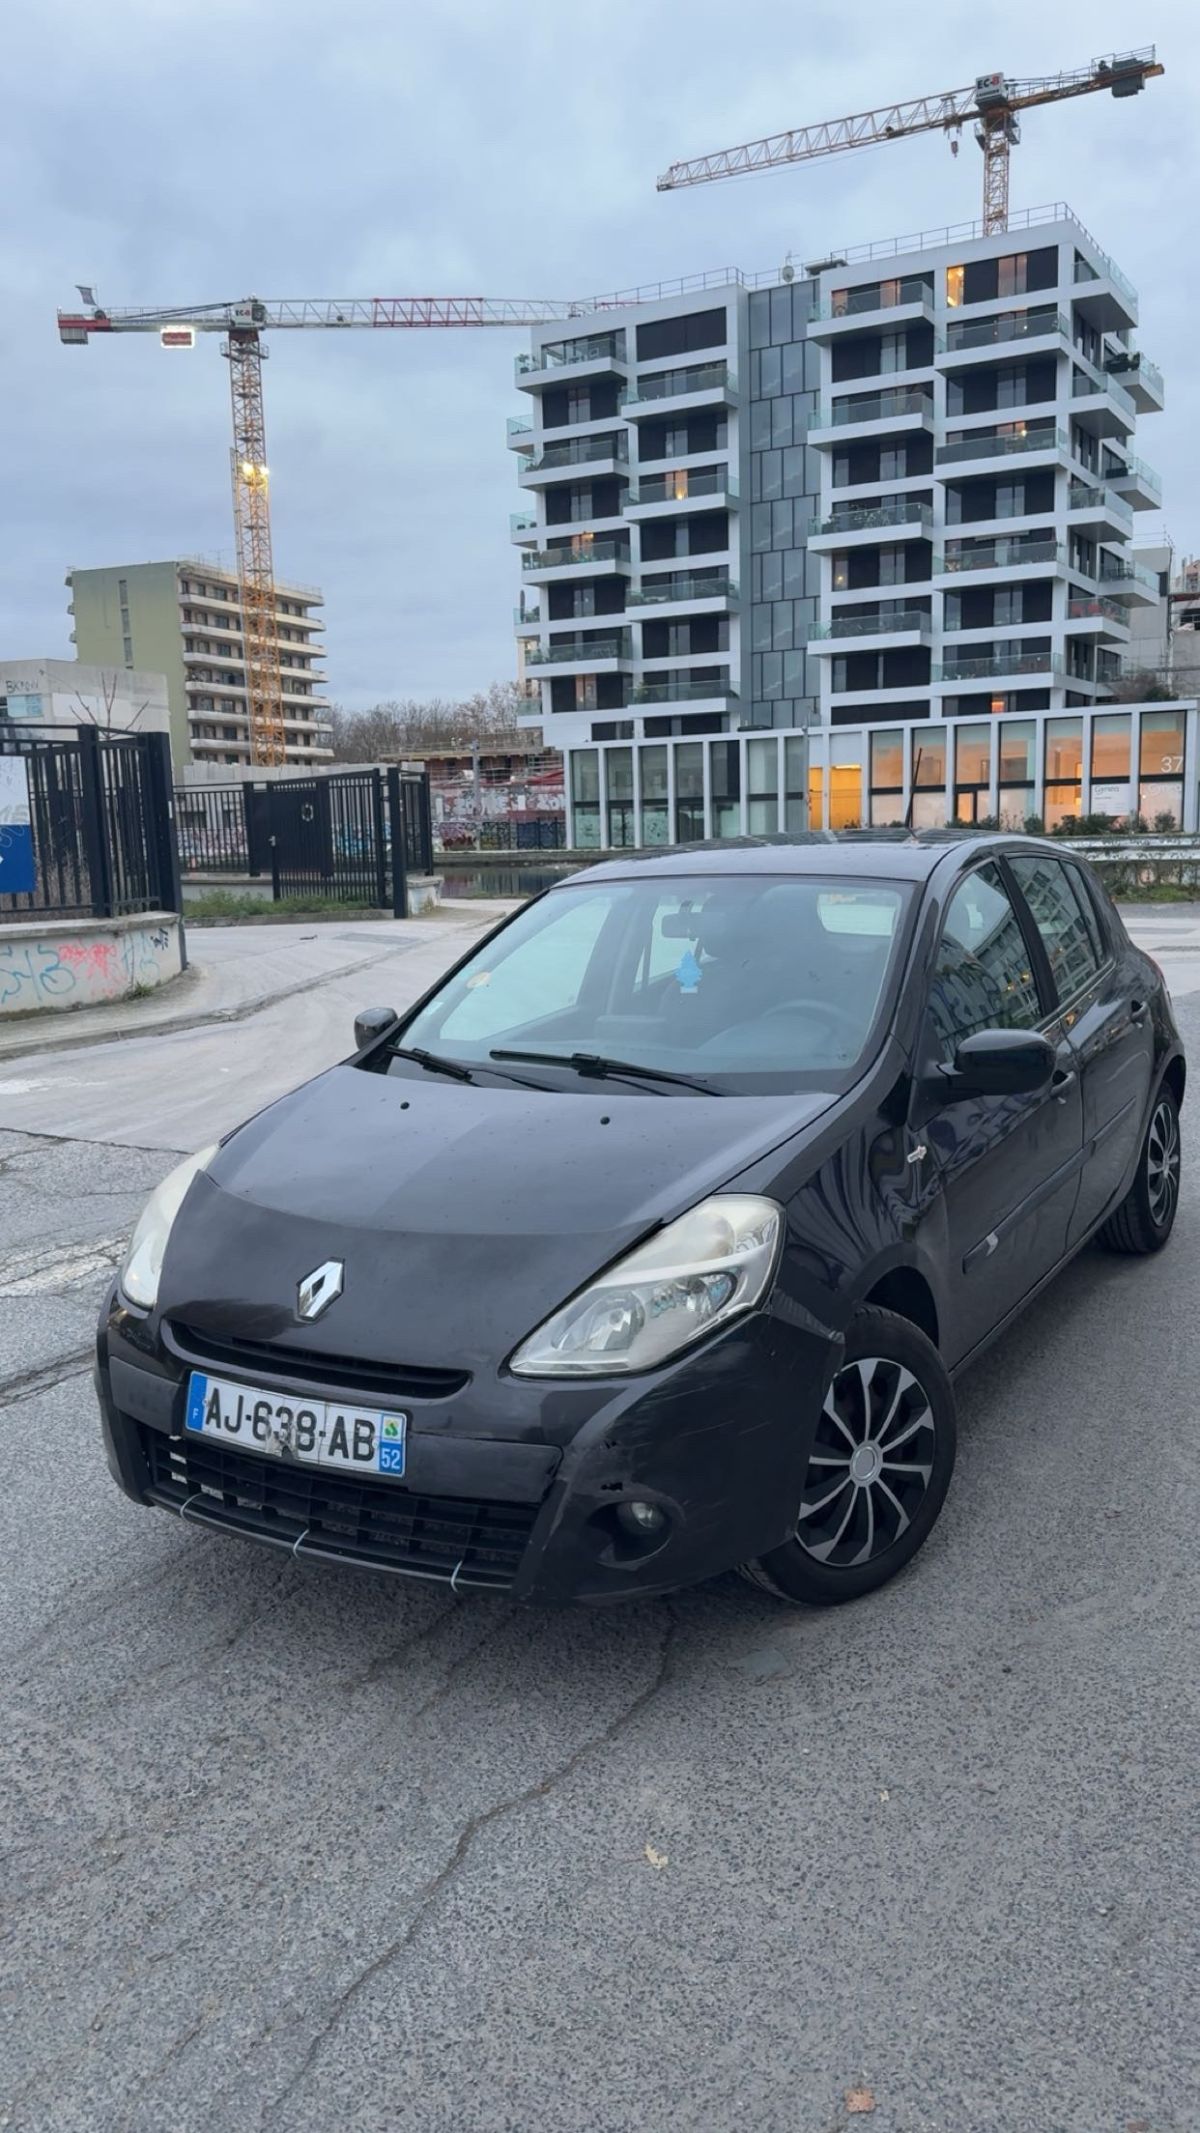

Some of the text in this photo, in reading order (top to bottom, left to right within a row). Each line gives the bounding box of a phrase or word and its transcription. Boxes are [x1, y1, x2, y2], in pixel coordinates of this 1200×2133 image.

[1161, 756, 1184, 773] 37
[193, 1408, 199, 1419] F
[205, 1388, 375, 1461] AJ-638-AB
[381, 1450, 401, 1469] 52
